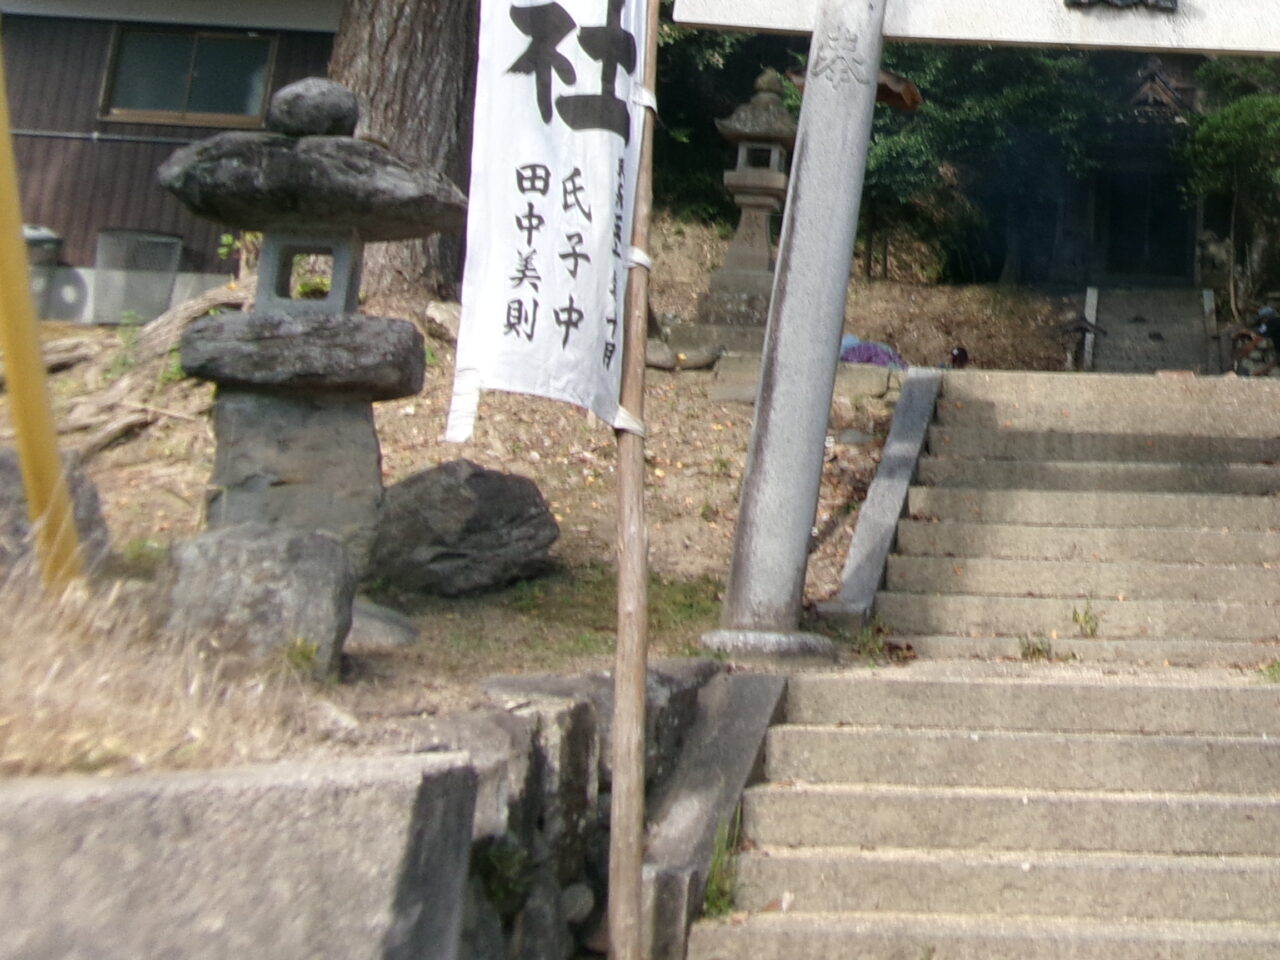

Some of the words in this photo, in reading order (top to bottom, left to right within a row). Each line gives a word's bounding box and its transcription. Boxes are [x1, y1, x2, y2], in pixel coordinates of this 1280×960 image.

[503, 163, 552, 342] 田中美則
[553, 166, 592, 350] 氏子中
